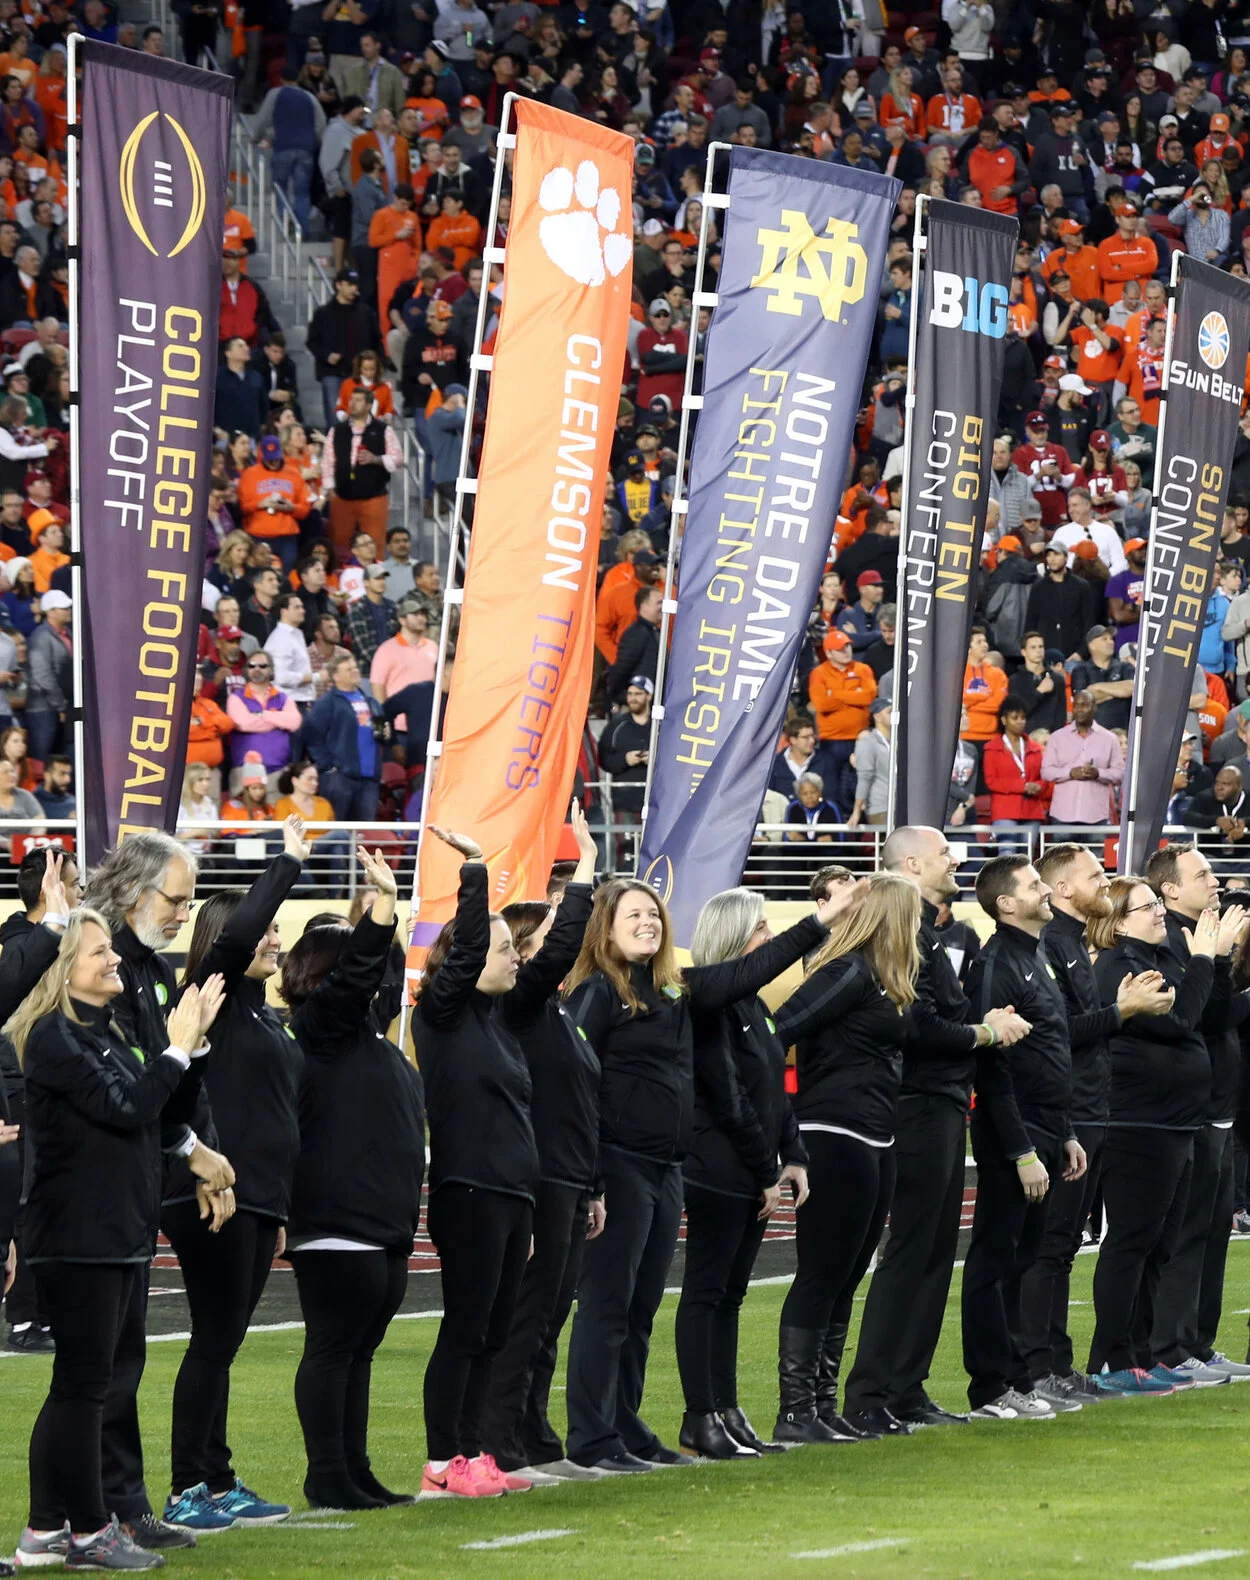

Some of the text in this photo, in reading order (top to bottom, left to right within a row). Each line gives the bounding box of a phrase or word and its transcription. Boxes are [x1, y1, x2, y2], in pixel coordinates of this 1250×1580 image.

[104, 298, 157, 531] PLAYOFF
[505, 333, 602, 791] CLEMSON TIGERS
[676, 367, 788, 767] FIGHTING IRISH
[732, 371, 837, 701] NOTRE DAME
[907, 410, 957, 690] CONFERENC
[935, 415, 983, 602] BIG TEN
[1163, 463, 1223, 668] SUN BELT
[117, 305, 202, 848] COLLEGE FOOTBALL
